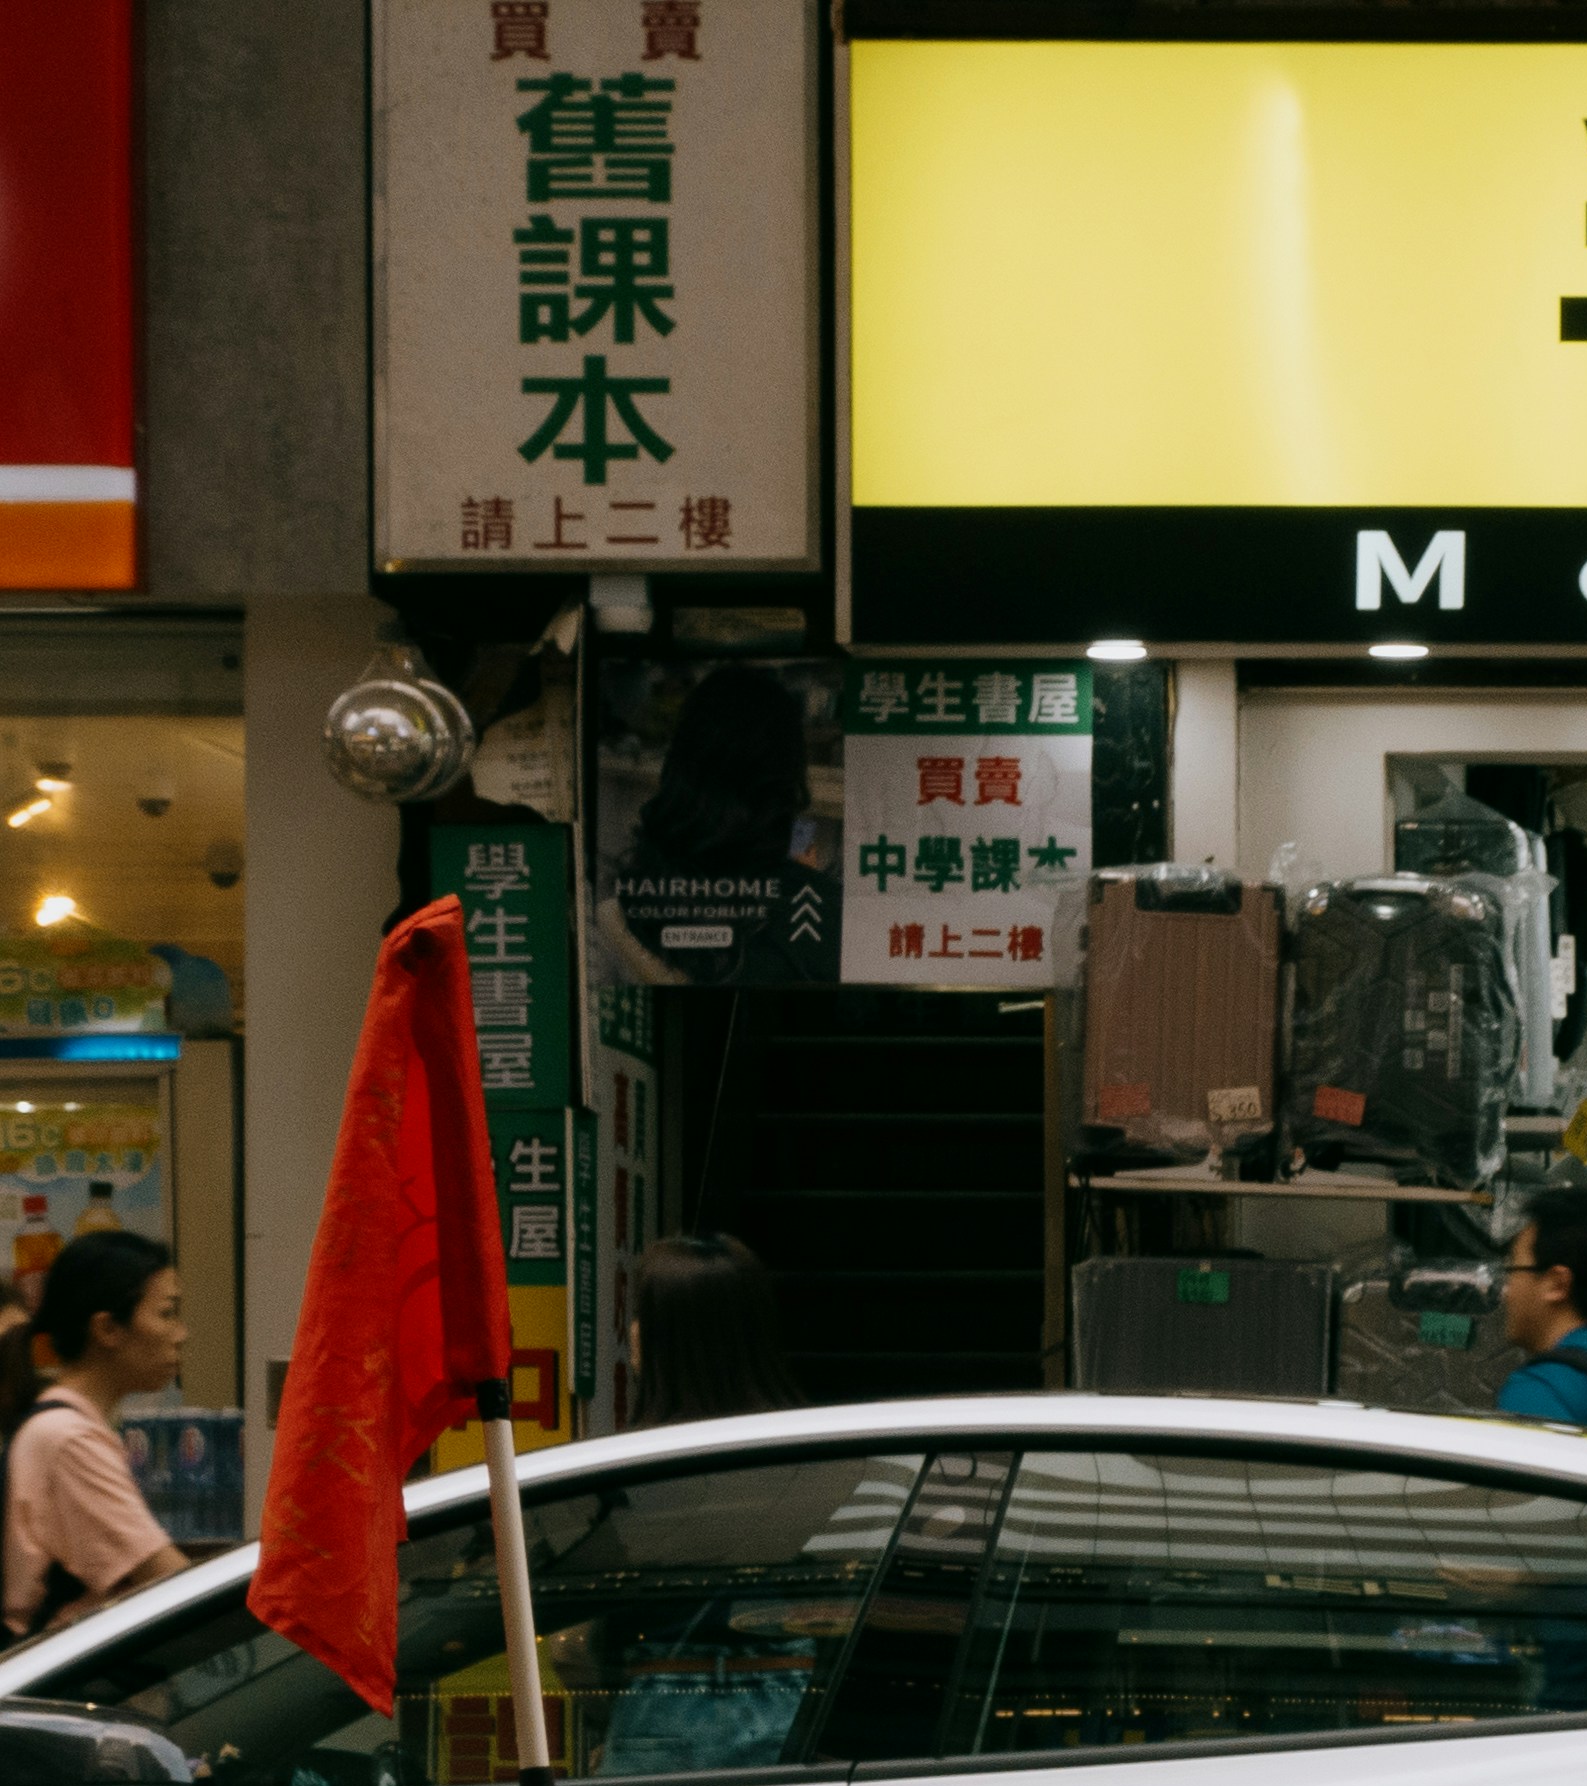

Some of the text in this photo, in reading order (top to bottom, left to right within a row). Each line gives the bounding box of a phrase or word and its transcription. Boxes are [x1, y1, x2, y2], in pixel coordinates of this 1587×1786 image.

[489, 0, 702, 62] 買賣
[513, 71, 677, 486] 舊課本
[460, 496, 733, 552] 請上二樓
[858, 671, 1080, 724] 學生書屋
[916, 755, 1023, 807] 買賣
[614, 877, 781, 898] HAIRHOME
[664, 930, 730, 943] ENTRANCE
[888, 920, 1044, 962] 請上二樓
[465, 842, 535, 1089] 學生書屋
